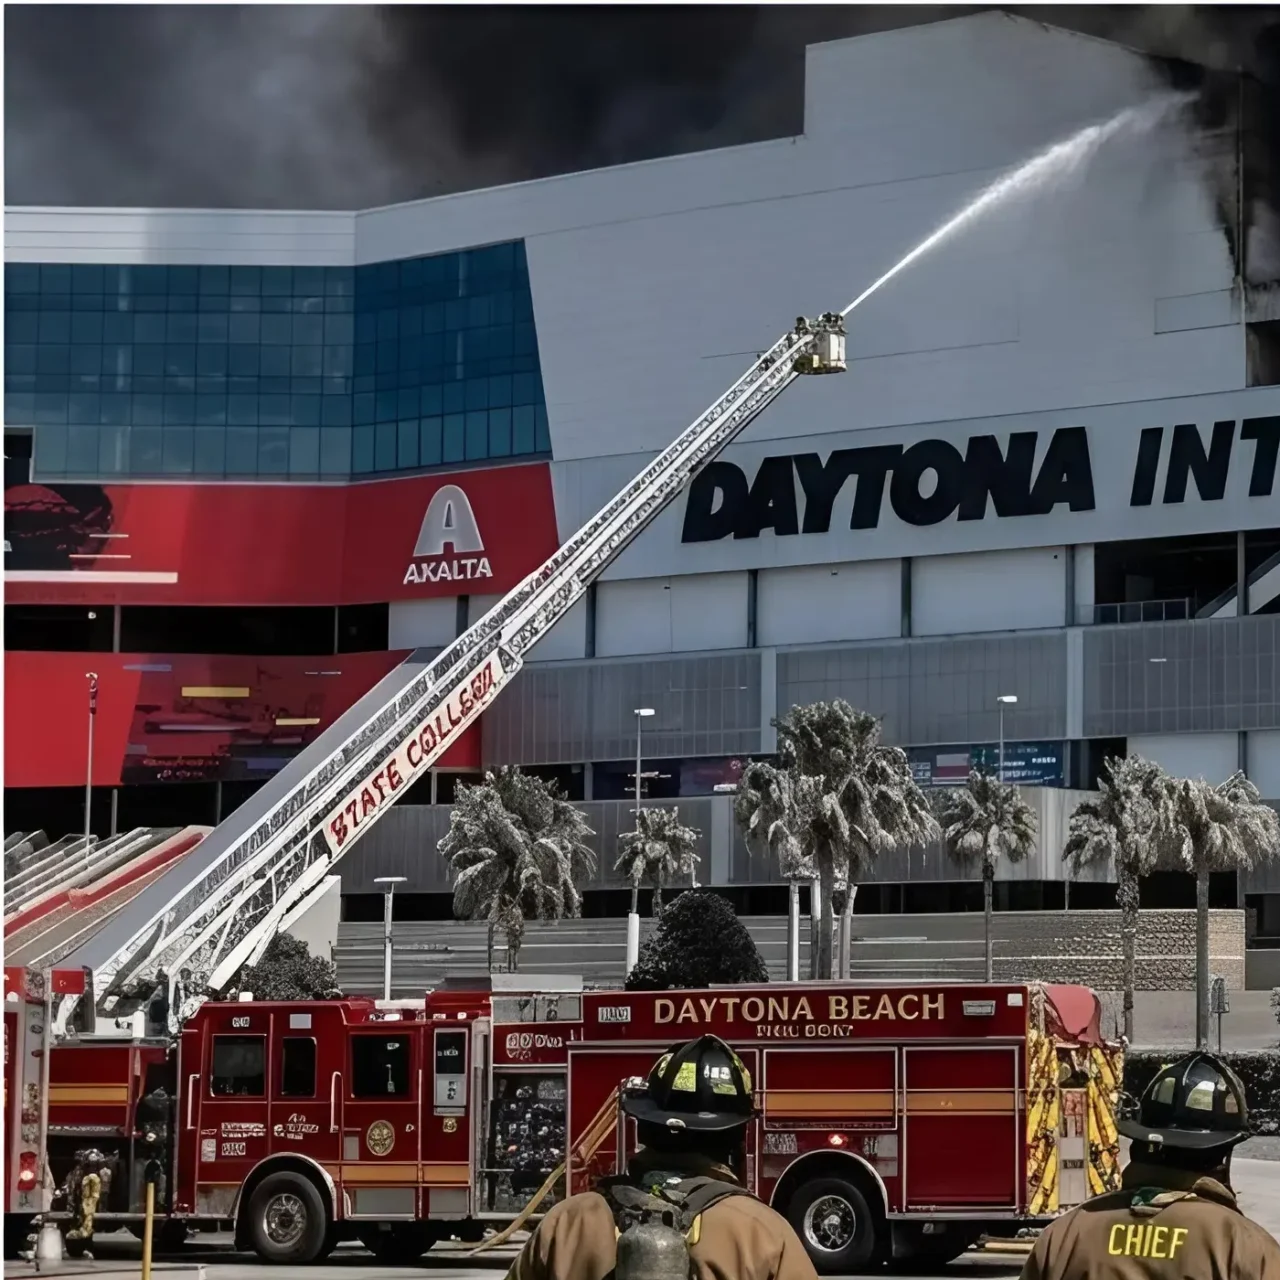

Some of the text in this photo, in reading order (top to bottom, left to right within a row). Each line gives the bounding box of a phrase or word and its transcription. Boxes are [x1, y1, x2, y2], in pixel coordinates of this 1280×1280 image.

[681, 426, 1096, 544] DAYTONA
[654, 996, 815, 1024] DAYTONA
[828, 993, 945, 1021] BEACH
[1108, 1223, 1189, 1259] CHIEF
